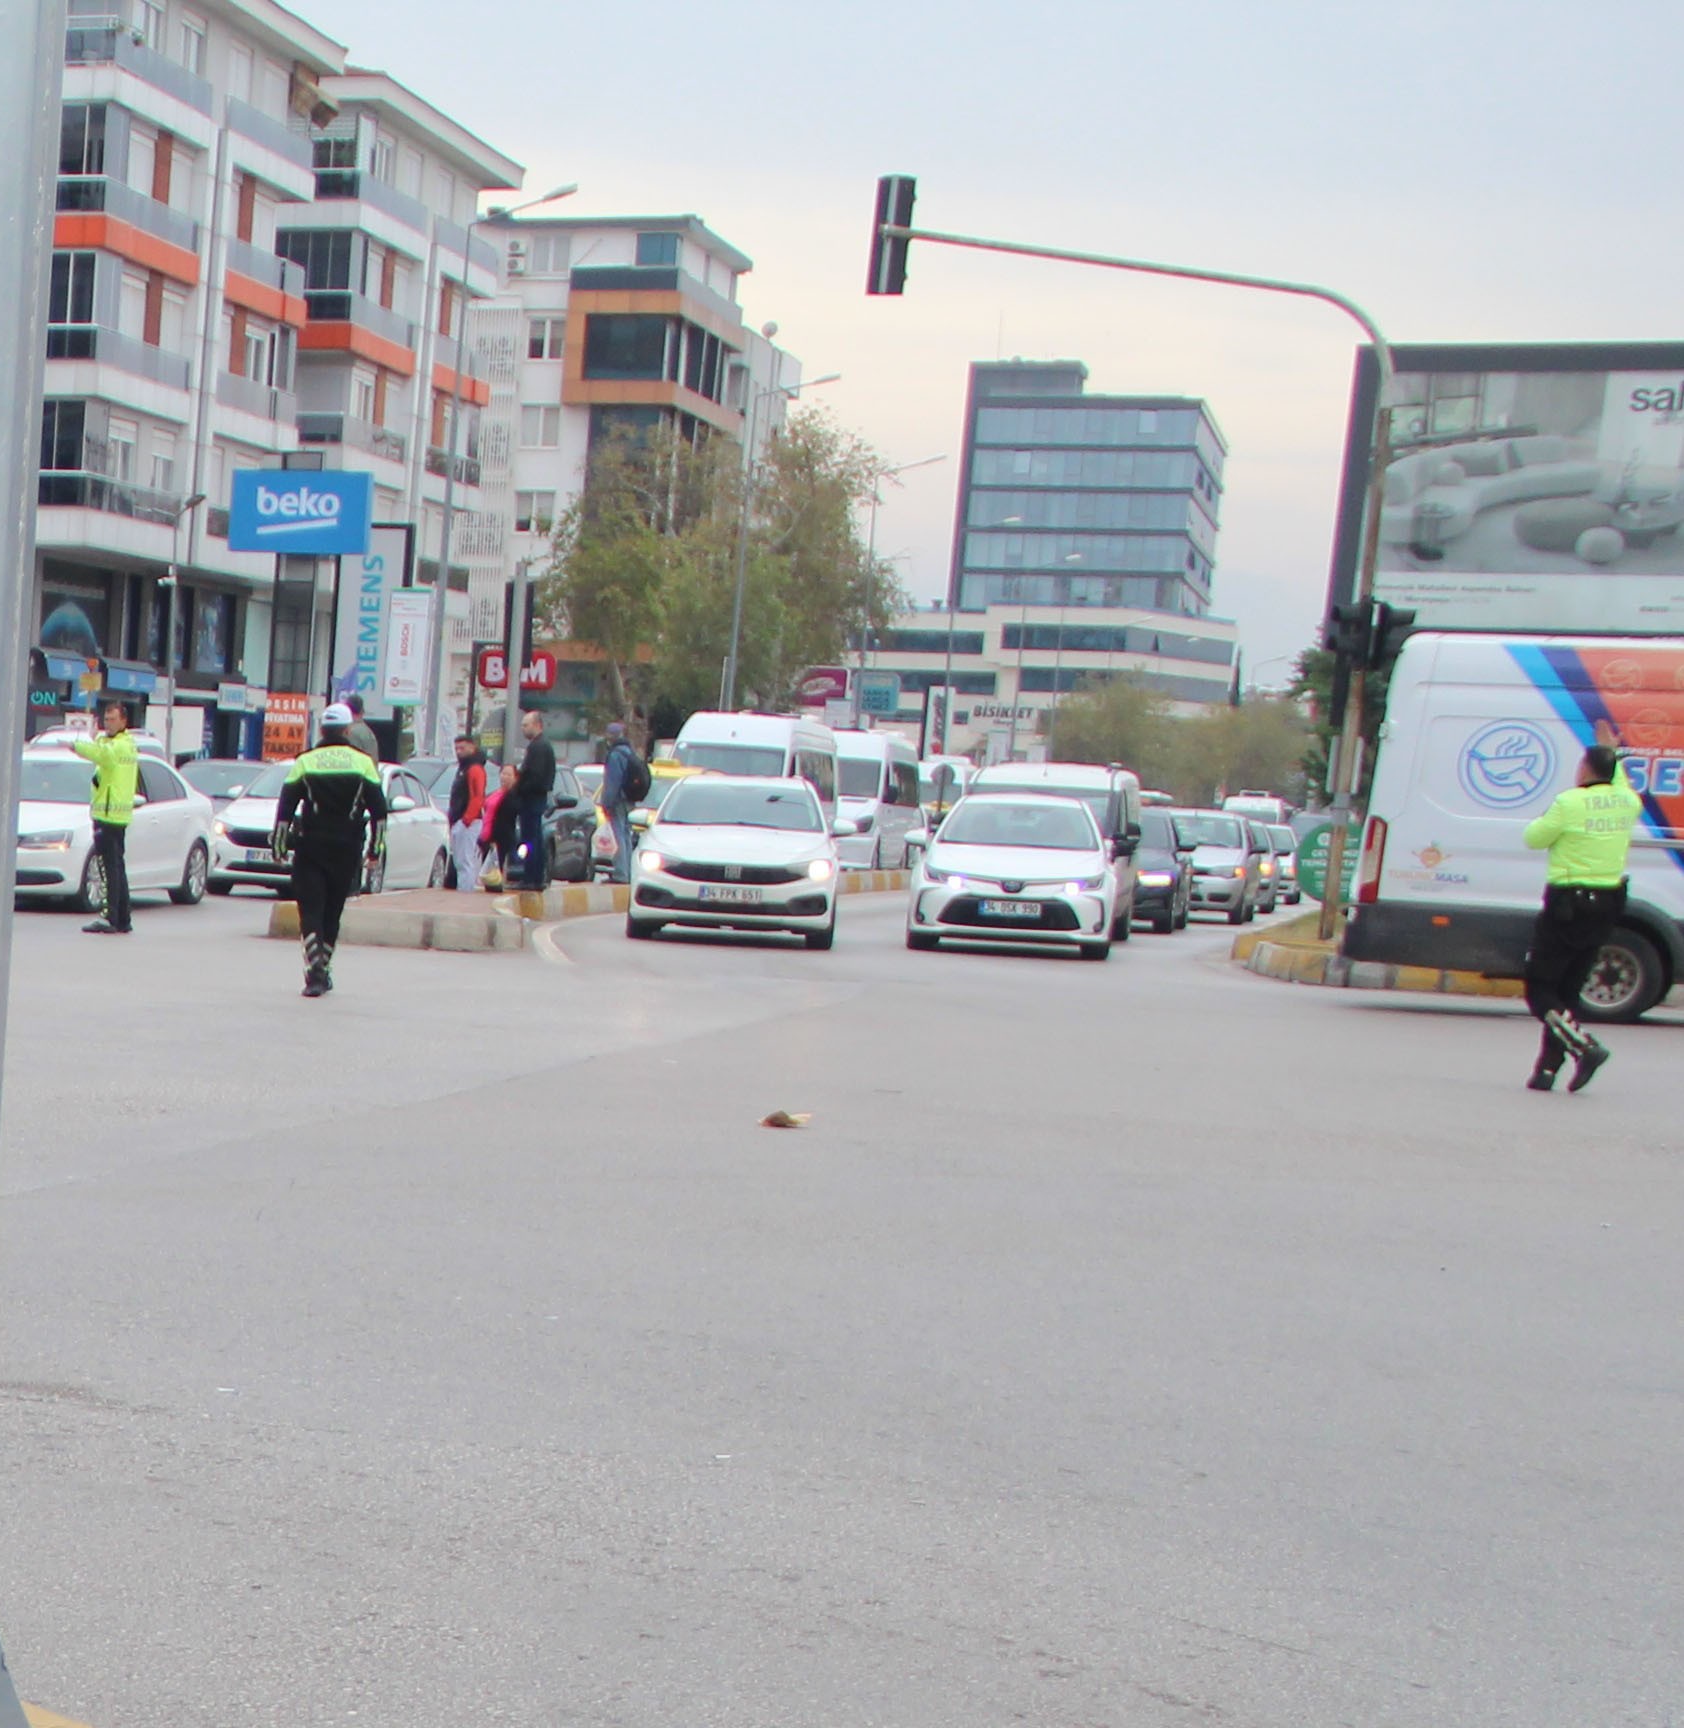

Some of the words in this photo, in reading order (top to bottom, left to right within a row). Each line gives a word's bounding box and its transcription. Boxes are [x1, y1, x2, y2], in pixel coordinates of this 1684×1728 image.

[256, 486, 341, 517] beko
[357, 554, 384, 692] SIEMENS
[485, 656, 547, 684] BM
[288, 726, 303, 738] AY
